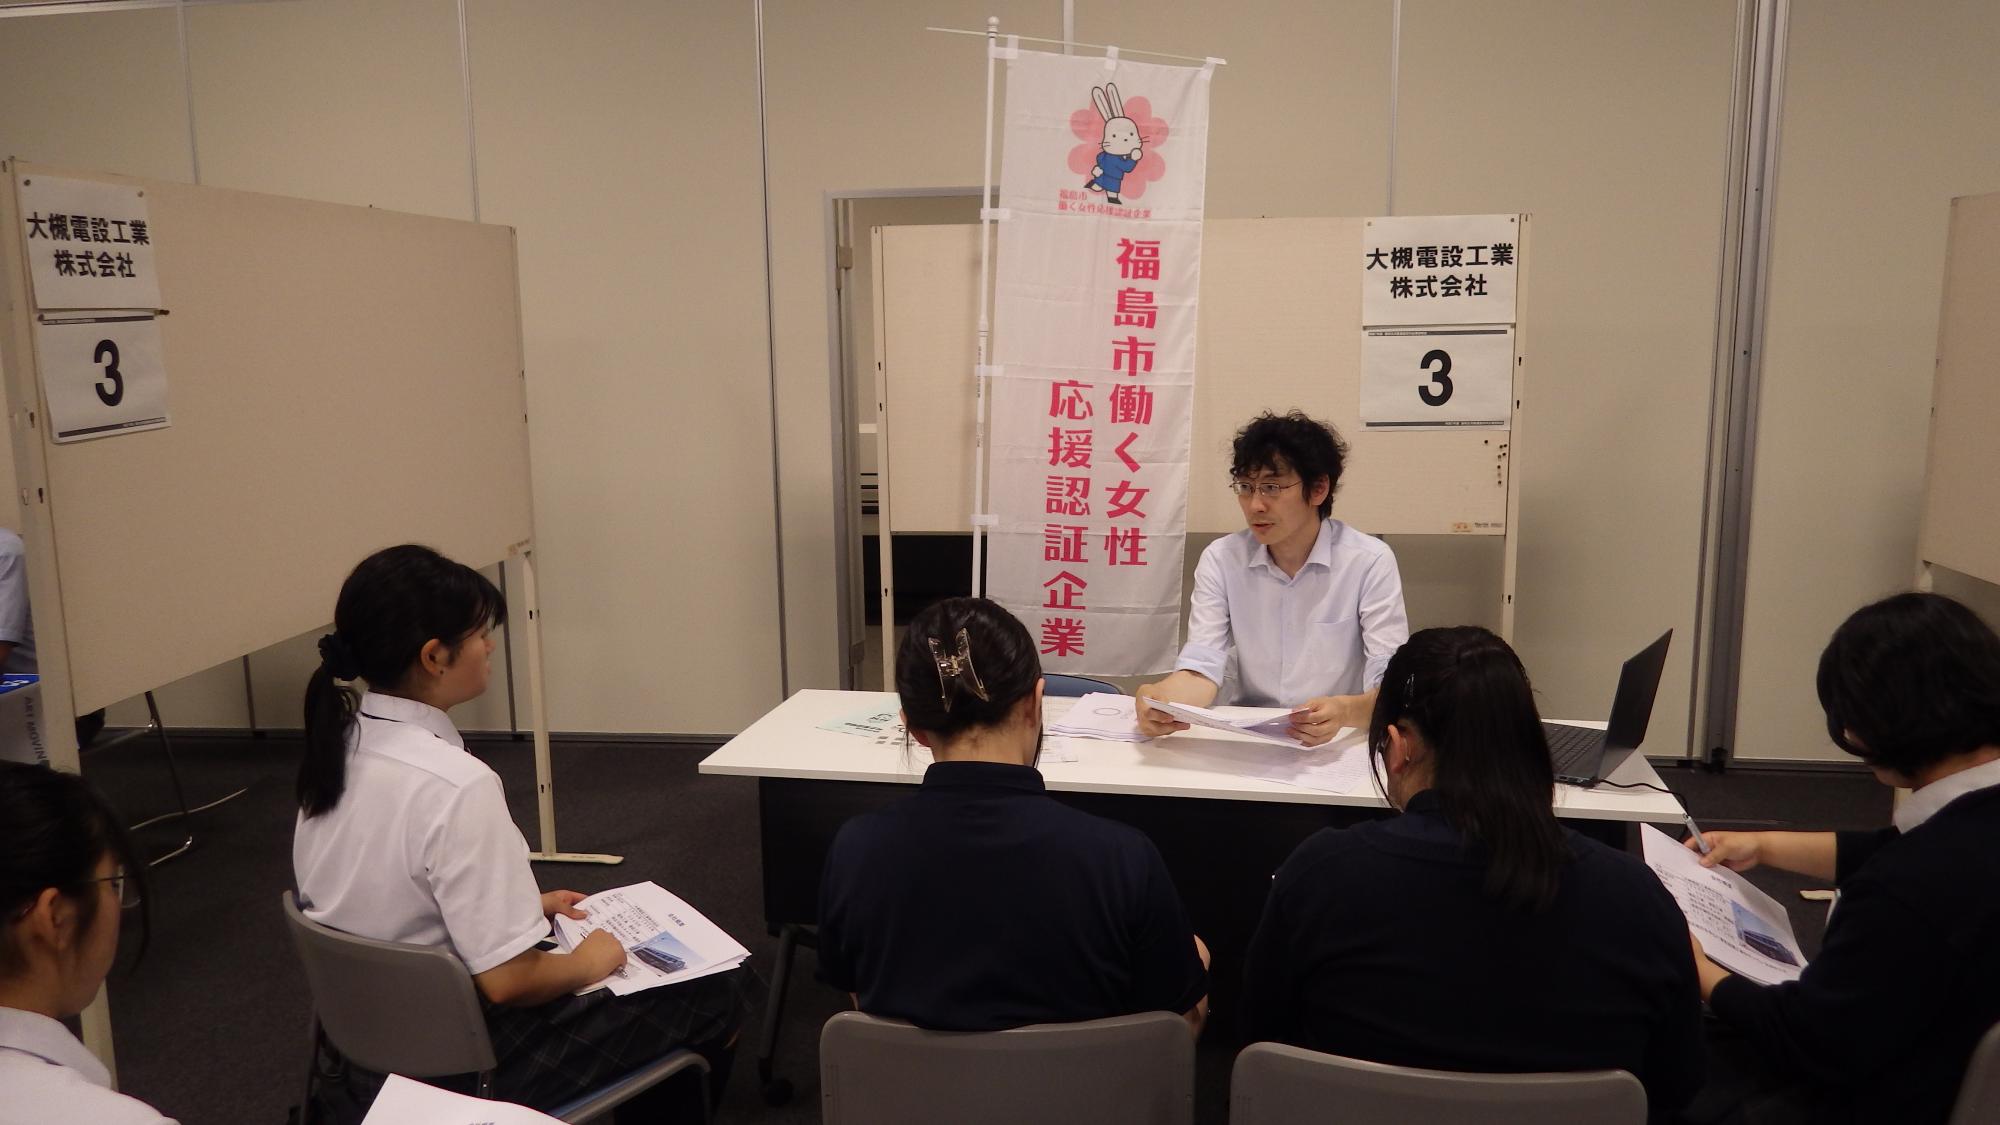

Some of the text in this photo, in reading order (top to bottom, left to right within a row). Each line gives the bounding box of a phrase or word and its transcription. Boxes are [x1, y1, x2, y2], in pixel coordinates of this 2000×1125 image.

[26, 212, 150, 245] 大槻電設工業
[54, 249, 137, 279] 株式会社
[1366, 243, 1514, 271] 大槻電設工業
[1390, 273, 1489, 299] 株式会社
[93, 338, 125, 407] 3
[1417, 349, 1454, 407] 3
[1103, 237, 1161, 567] 福島市働く女性
[1040, 379, 1095, 657] 応援認証企業
